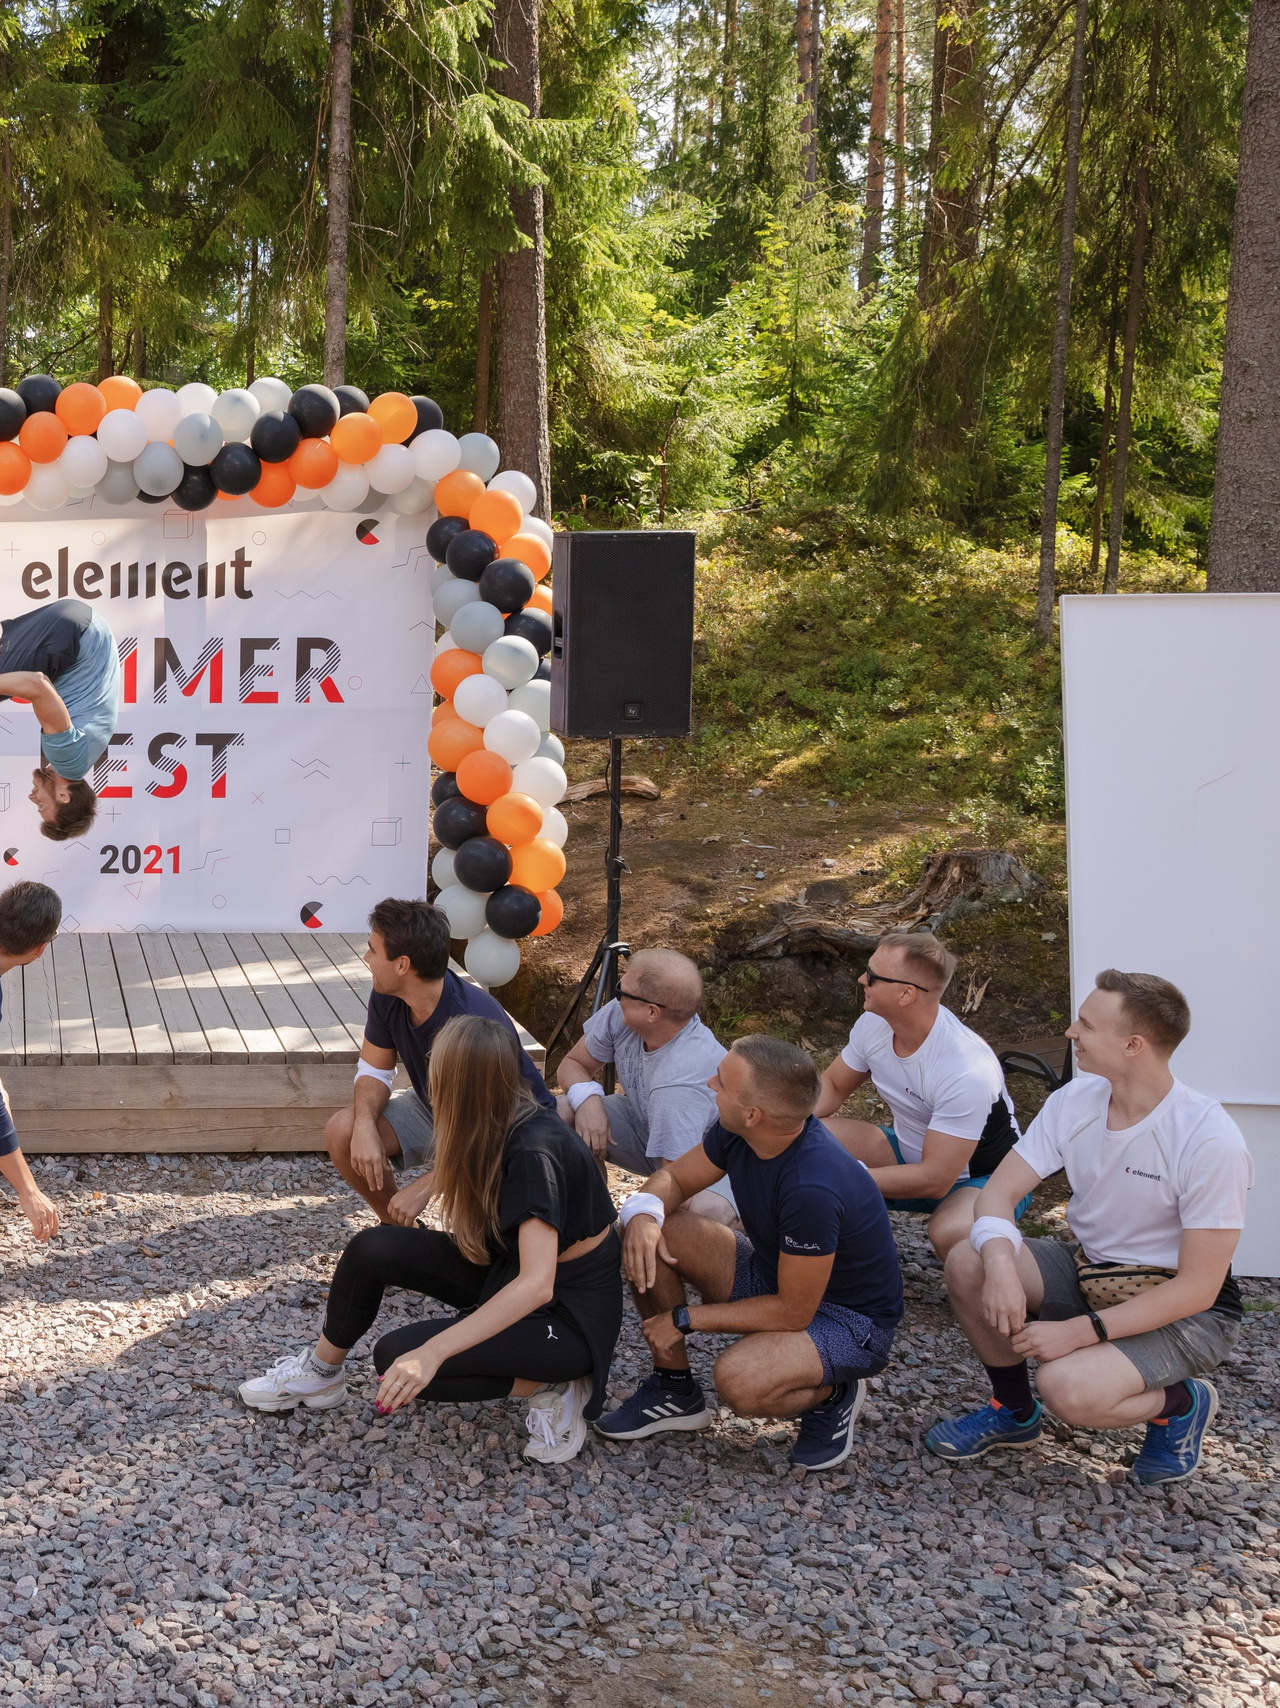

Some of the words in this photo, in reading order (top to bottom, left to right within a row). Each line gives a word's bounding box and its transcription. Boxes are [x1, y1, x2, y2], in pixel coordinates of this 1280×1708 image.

[21, 546, 254, 599] element
[40, 732, 245, 798] EST
[99, 844, 181, 874] 2021
